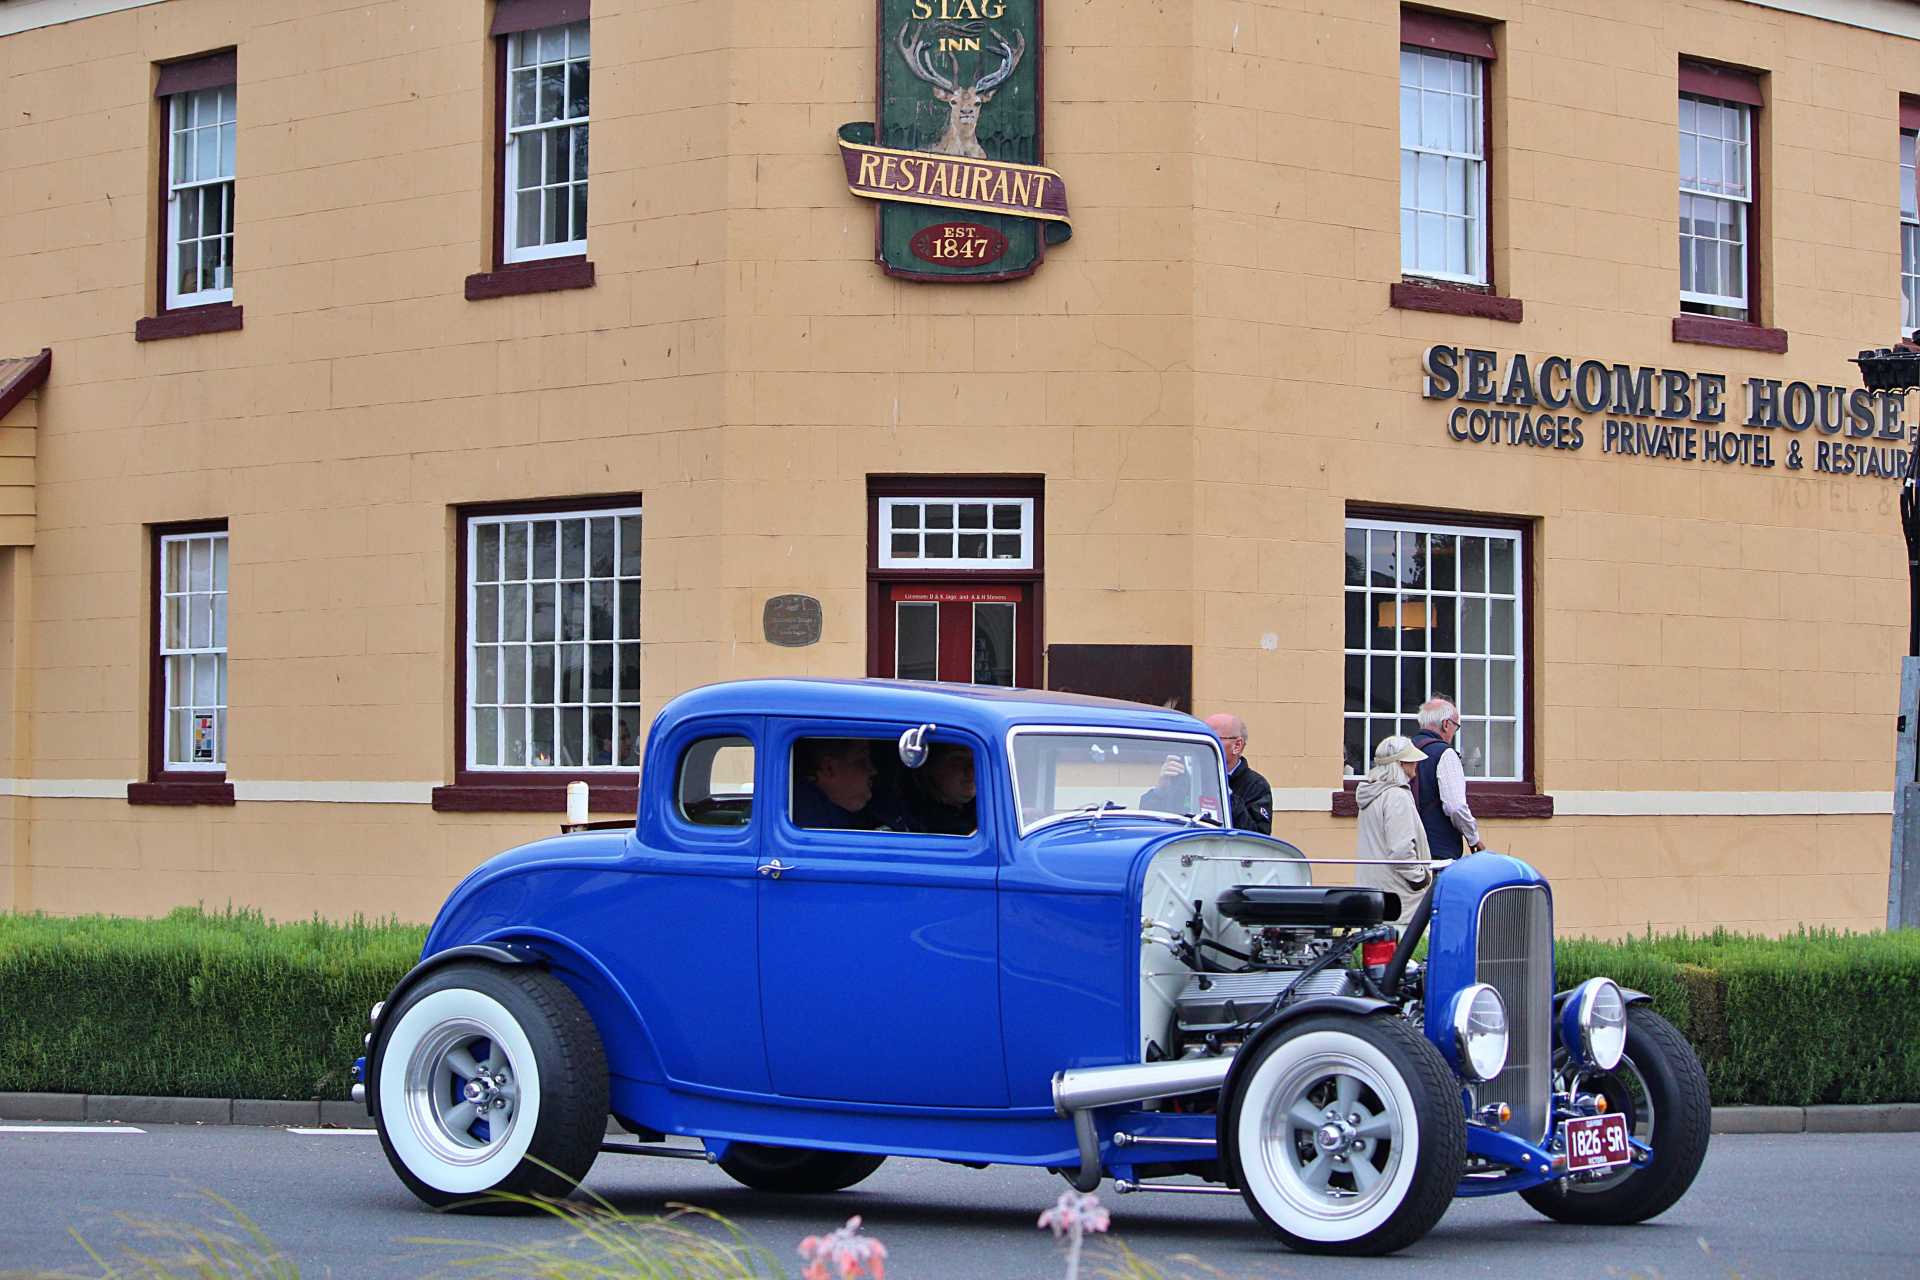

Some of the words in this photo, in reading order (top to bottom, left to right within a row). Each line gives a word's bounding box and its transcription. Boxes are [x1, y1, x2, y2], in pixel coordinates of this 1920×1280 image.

[911, 0, 1007, 20] STAG
[938, 37, 981, 51] INN
[856, 153, 1052, 209] RESTAURANT
[943, 227, 976, 238] EST
[932, 239, 988, 258] 1847
[1423, 344, 1727, 422] SEACOMBE
[1744, 376, 1905, 441] HOUSE
[1448, 406, 1584, 451] COTTAGES
[1602, 419, 1697, 461] PRIVATE
[1704, 430, 1775, 468] HOTEL
[1785, 438, 1804, 471] &
